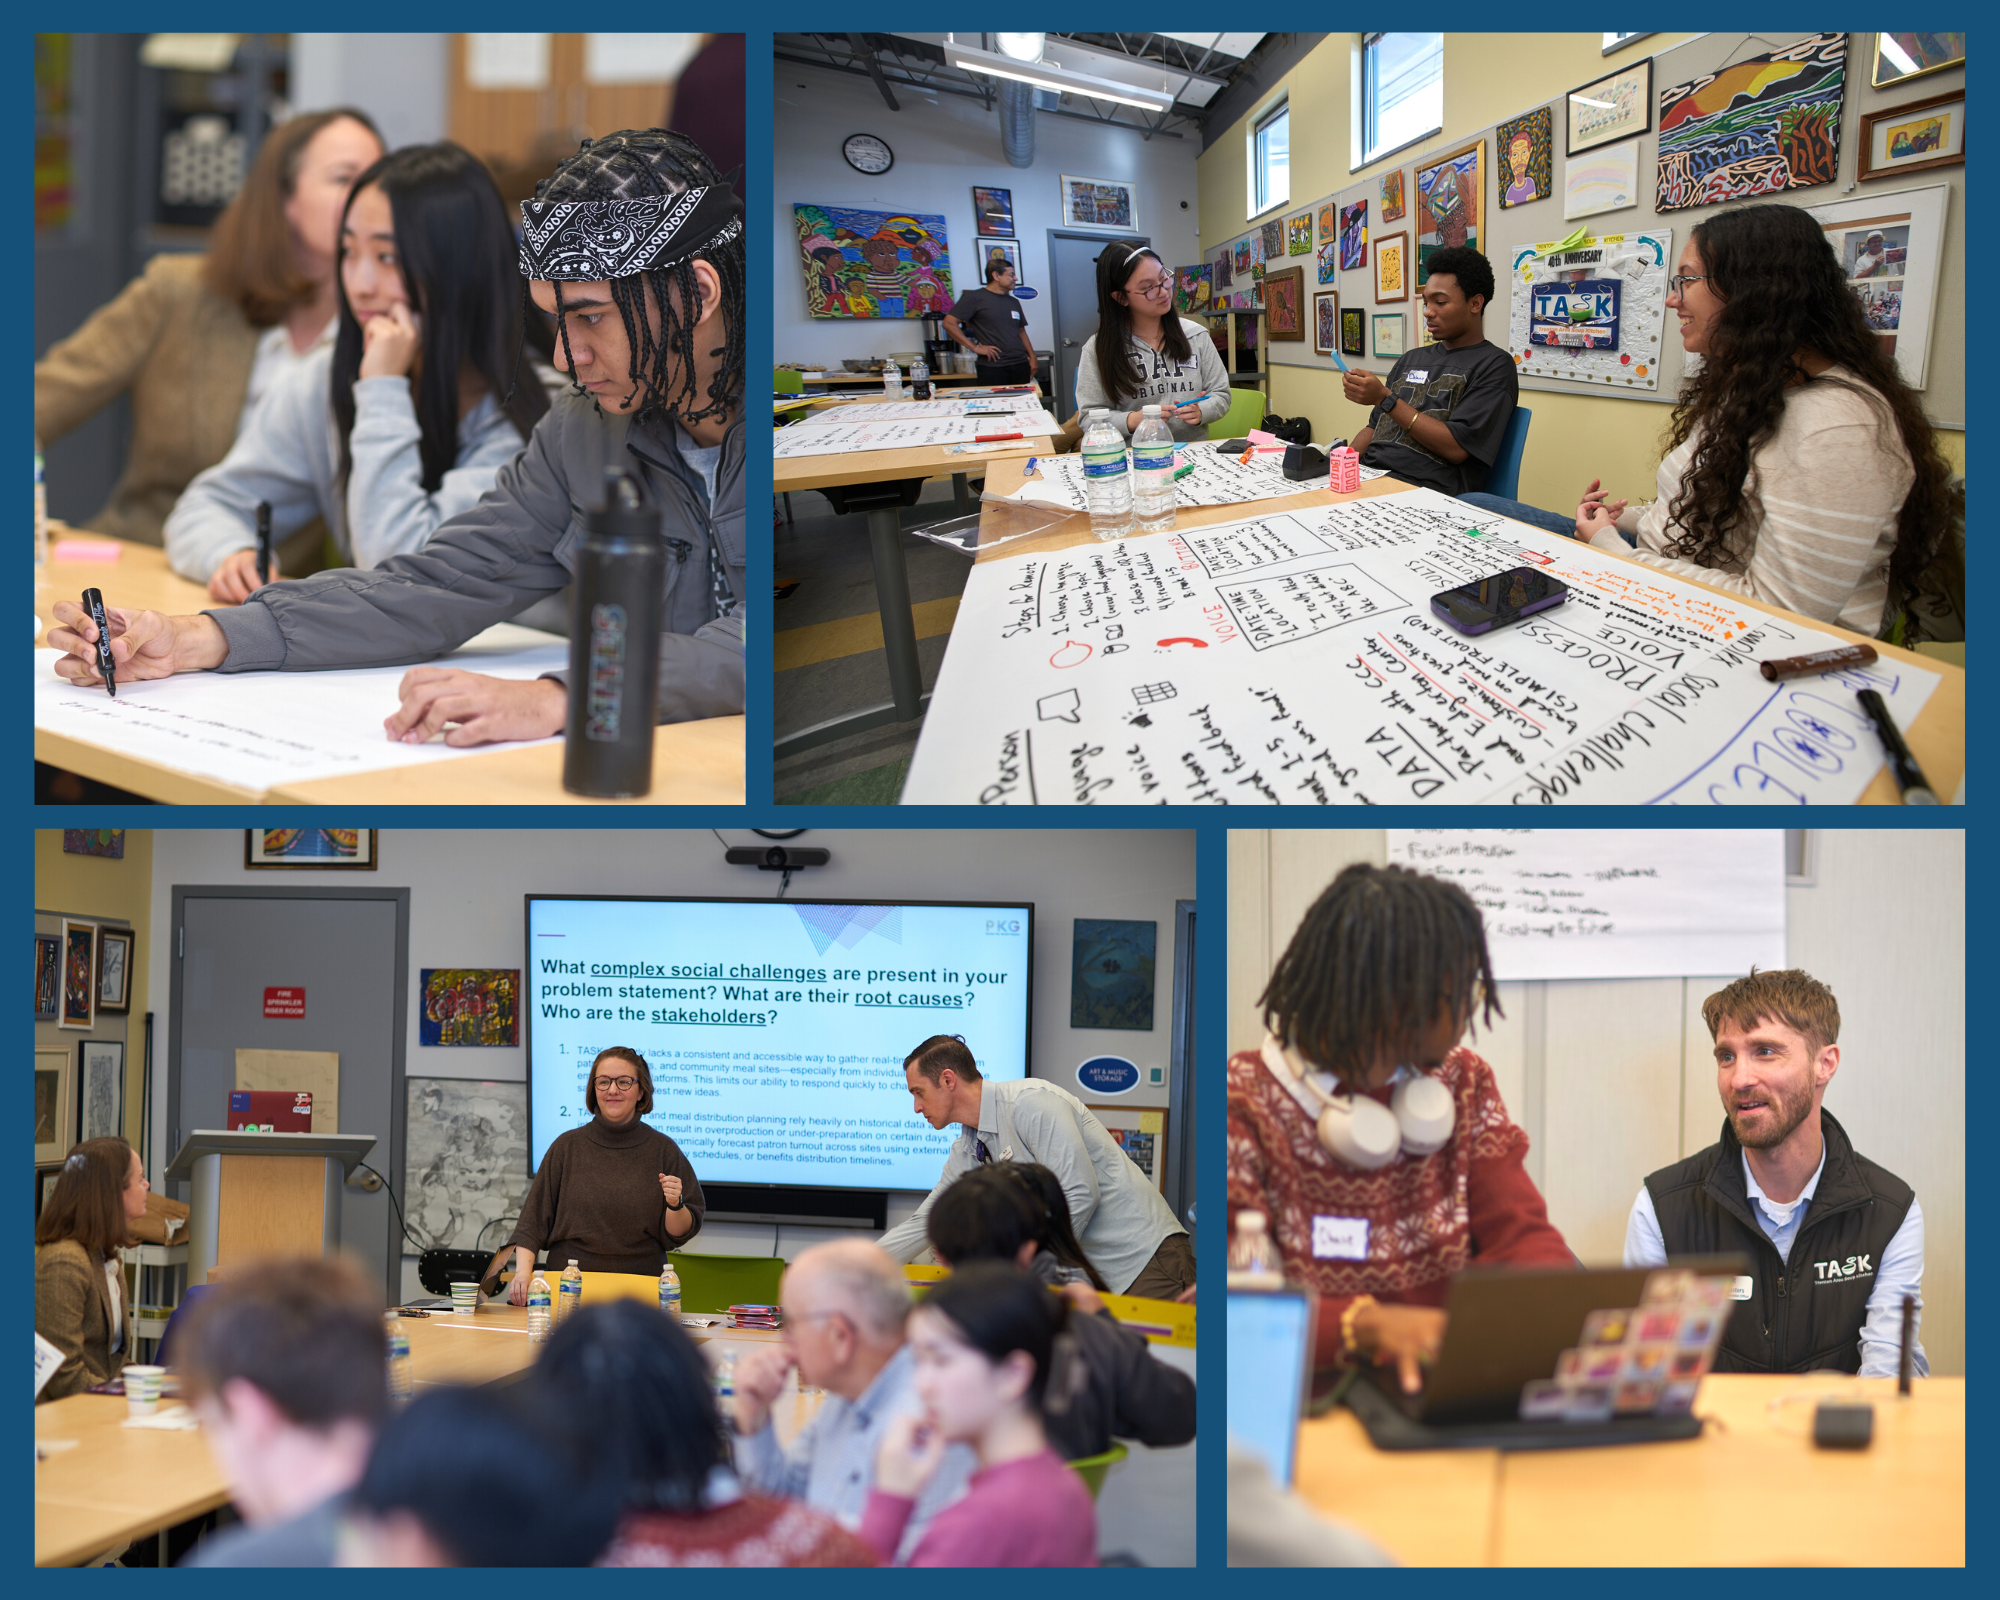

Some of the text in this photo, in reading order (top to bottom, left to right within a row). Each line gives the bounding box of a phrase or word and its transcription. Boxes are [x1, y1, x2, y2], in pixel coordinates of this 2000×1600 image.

[1564, 250, 1602, 264] ANNIVERSARY
[1538, 294, 1612, 318] TASK
[1127, 352, 1183, 384] GA
[1168, 538, 1200, 570] BUTTONS
[1002, 562, 1038, 638] Steps for Remote
[1203, 604, 1238, 644] VOICE
[1604, 611, 1701, 650] sentiment
[1609, 600, 1715, 644] most common
[1596, 628, 1685, 670] VOICE
[1346, 658, 1383, 688] CCC
[1393, 634, 1542, 740] Customize questions
[1457, 657, 1578, 735] based on need
[1363, 636, 1525, 765] and Edgerton Center
[1190, 704, 1246, 774] feedback
[1292, 720, 1316, 745] was
[1266, 738, 1304, 770] 1-5
[1365, 726, 1445, 798] DATA
[1127, 744, 1160, 793] voice
[986, 920, 1020, 932] PKG
[542, 959, 1008, 986] What complex social challenges are present in your
[266, 998, 302, 1006] SPRINKLER
[277, 990, 292, 998] FIRE
[542, 982, 975, 1007] problem statement? What are their root causes?
[542, 1004, 778, 1024] Who are the stakeholders?
[559, 1044, 570, 1054] 1.
[648, 1049, 672, 1058] lacks
[684, 1050, 730, 1060] consistent
[734, 1052, 750, 1060] and
[753, 1052, 802, 1062] accessible
[805, 1055, 824, 1064] way
[839, 1054, 868, 1064] gather
[660, 1062, 676, 1070] and
[680, 1063, 730, 1072] community
[733, 1064, 756, 1072] meal
[840, 1066, 860, 1076] from
[1089, 1068, 1101, 1076] ART
[1094, 1074, 1123, 1083] STORAGE
[673, 1088, 722, 1097] new ideas.
[694, 1075, 876, 1091] This limits ability respond quickly
[560, 1106, 925, 1129] 2. and meal distribution planning rely heavily historical data
[666, 1125, 950, 1144] result overproduction under-preparation certain days.
[718, 1138, 952, 1156] forecast patron turnout across sites using external
[693, 1150, 895, 1166] schedules, benefits distribution timelines.
[1814, 1254, 1872, 1280] TASK
